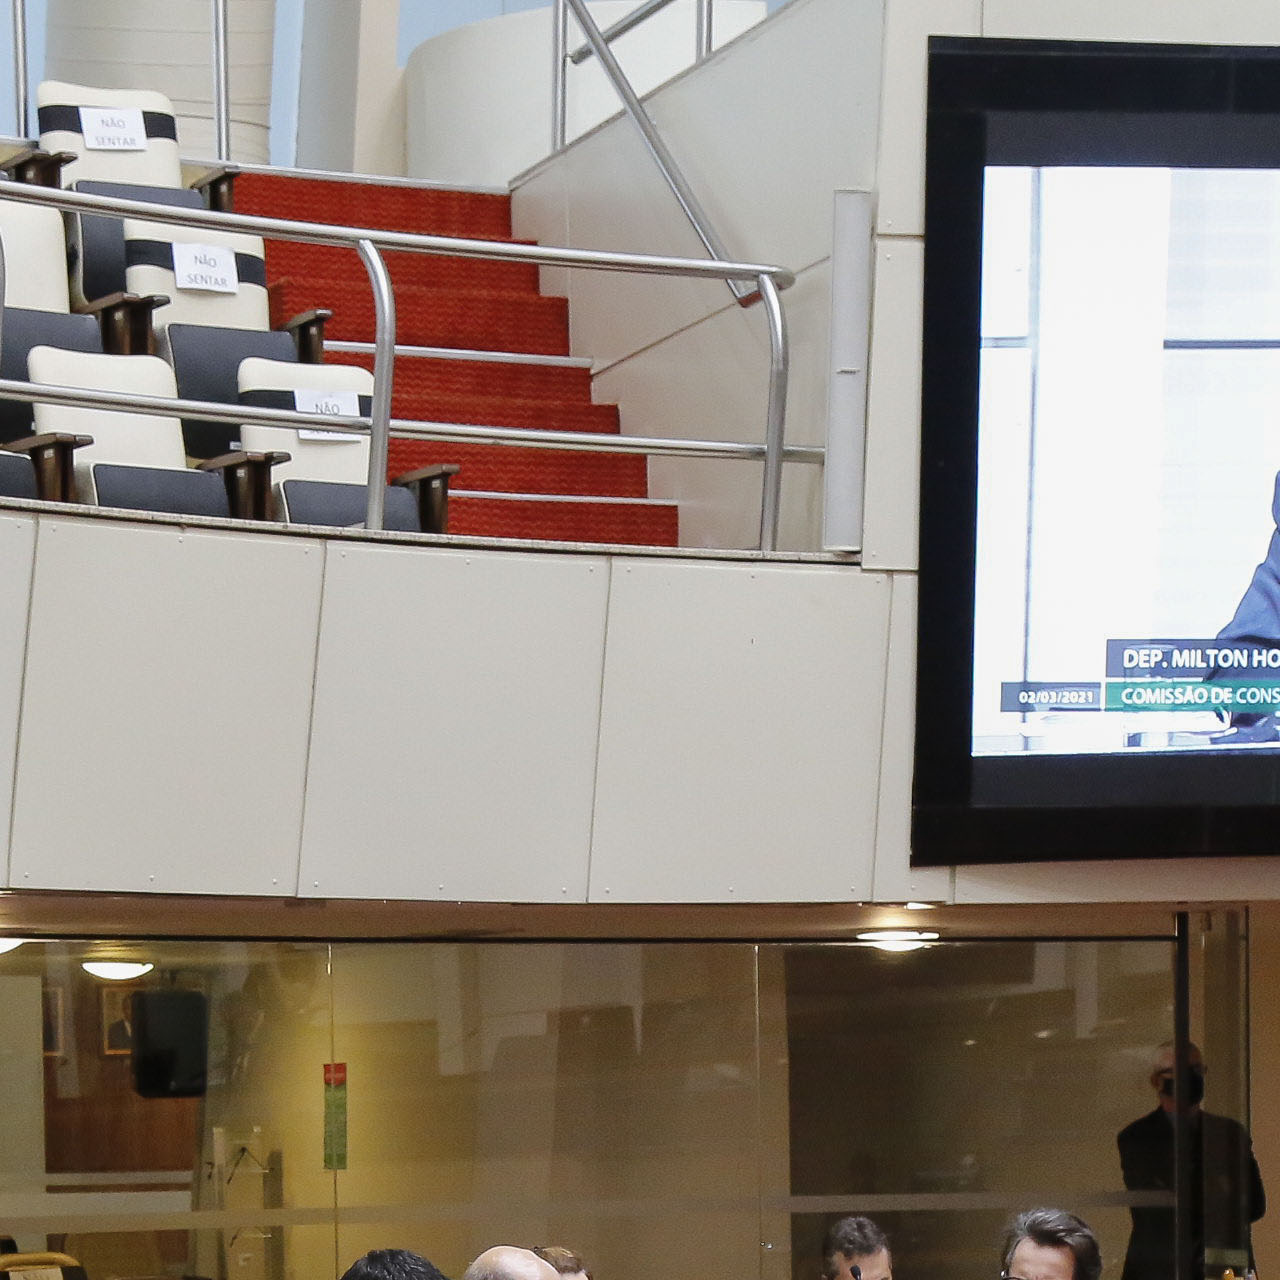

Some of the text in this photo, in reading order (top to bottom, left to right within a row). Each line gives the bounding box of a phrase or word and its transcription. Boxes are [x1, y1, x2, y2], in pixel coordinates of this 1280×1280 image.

[315, 402, 340, 416] NÃO
[1123, 649, 1168, 669] DEP.
[1171, 649, 1248, 669] MILTON
[1019, 690, 1095, 704] 02/03/2021
[1121, 683, 1208, 705] COMISSÃO
[1211, 687, 1232, 704] DE
